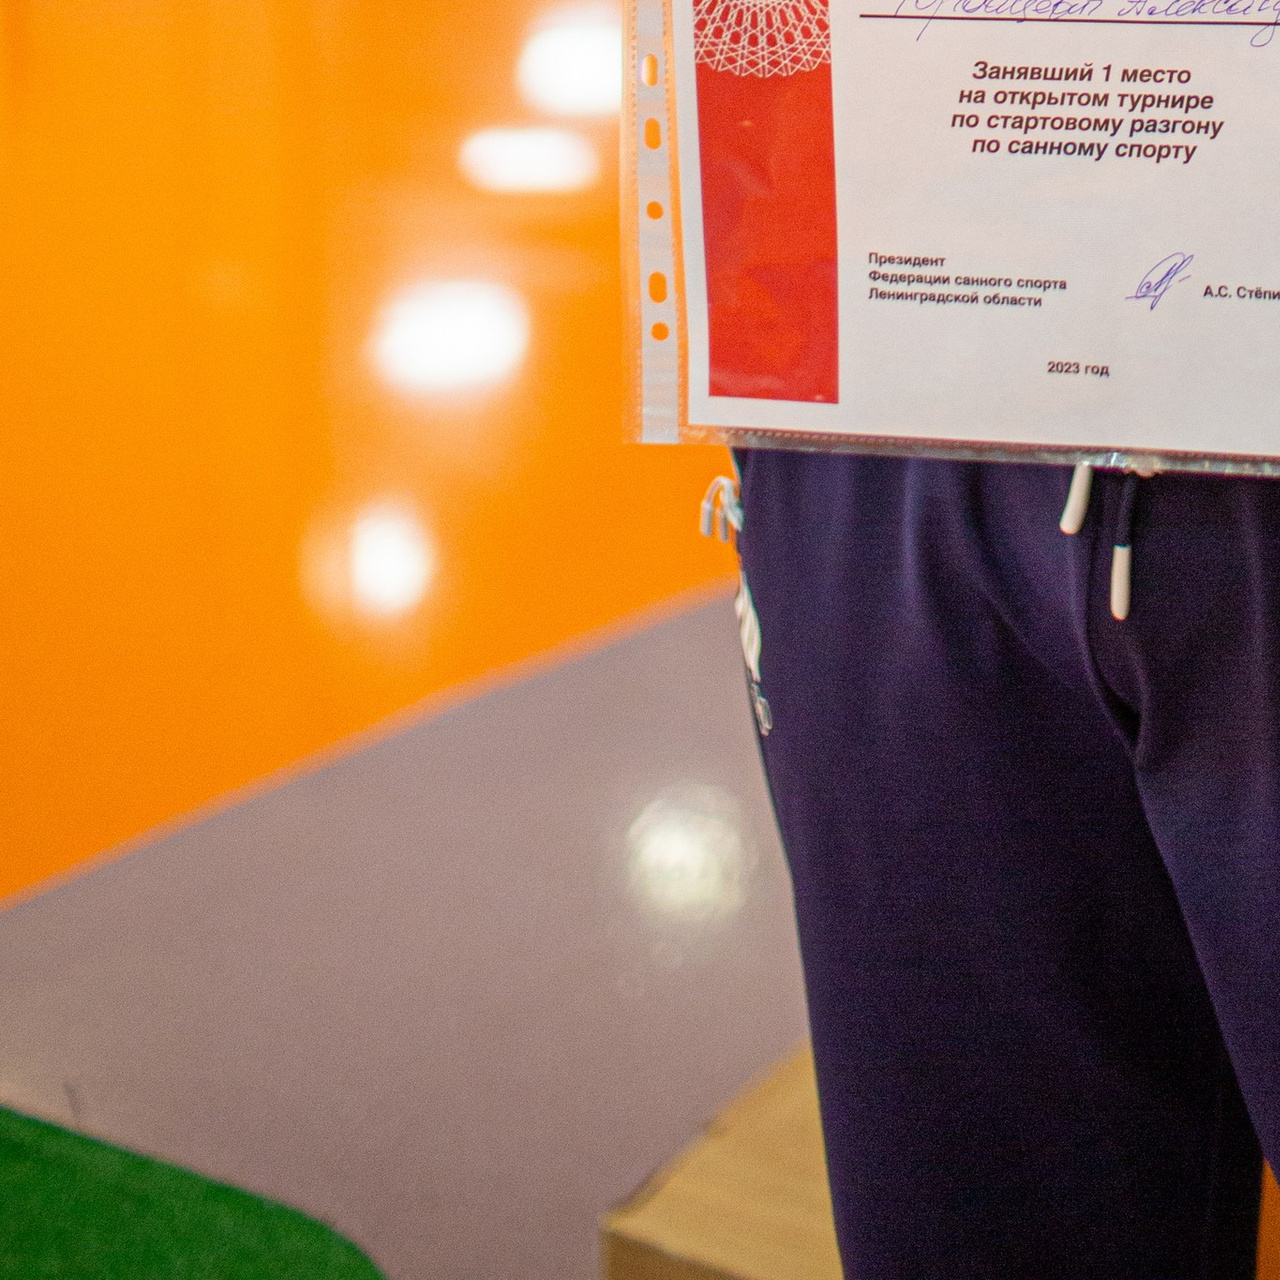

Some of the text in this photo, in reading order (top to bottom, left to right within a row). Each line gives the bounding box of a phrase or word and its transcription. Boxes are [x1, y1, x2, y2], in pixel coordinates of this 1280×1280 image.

[972, 60, 1192, 84] Занявший 1 место
[958, 89, 1214, 114] на открытом турнире
[951, 113, 1225, 140] по стартовому разгону
[971, 138, 1198, 165] по санному спорту
[868, 251, 946, 268] Президент
[868, 270, 1067, 292] Федерации санного спорта
[1203, 284, 1232, 299] А.С.
[868, 287, 1043, 307] Ленинградской области
[1047, 360, 1110, 378] 2023 год
